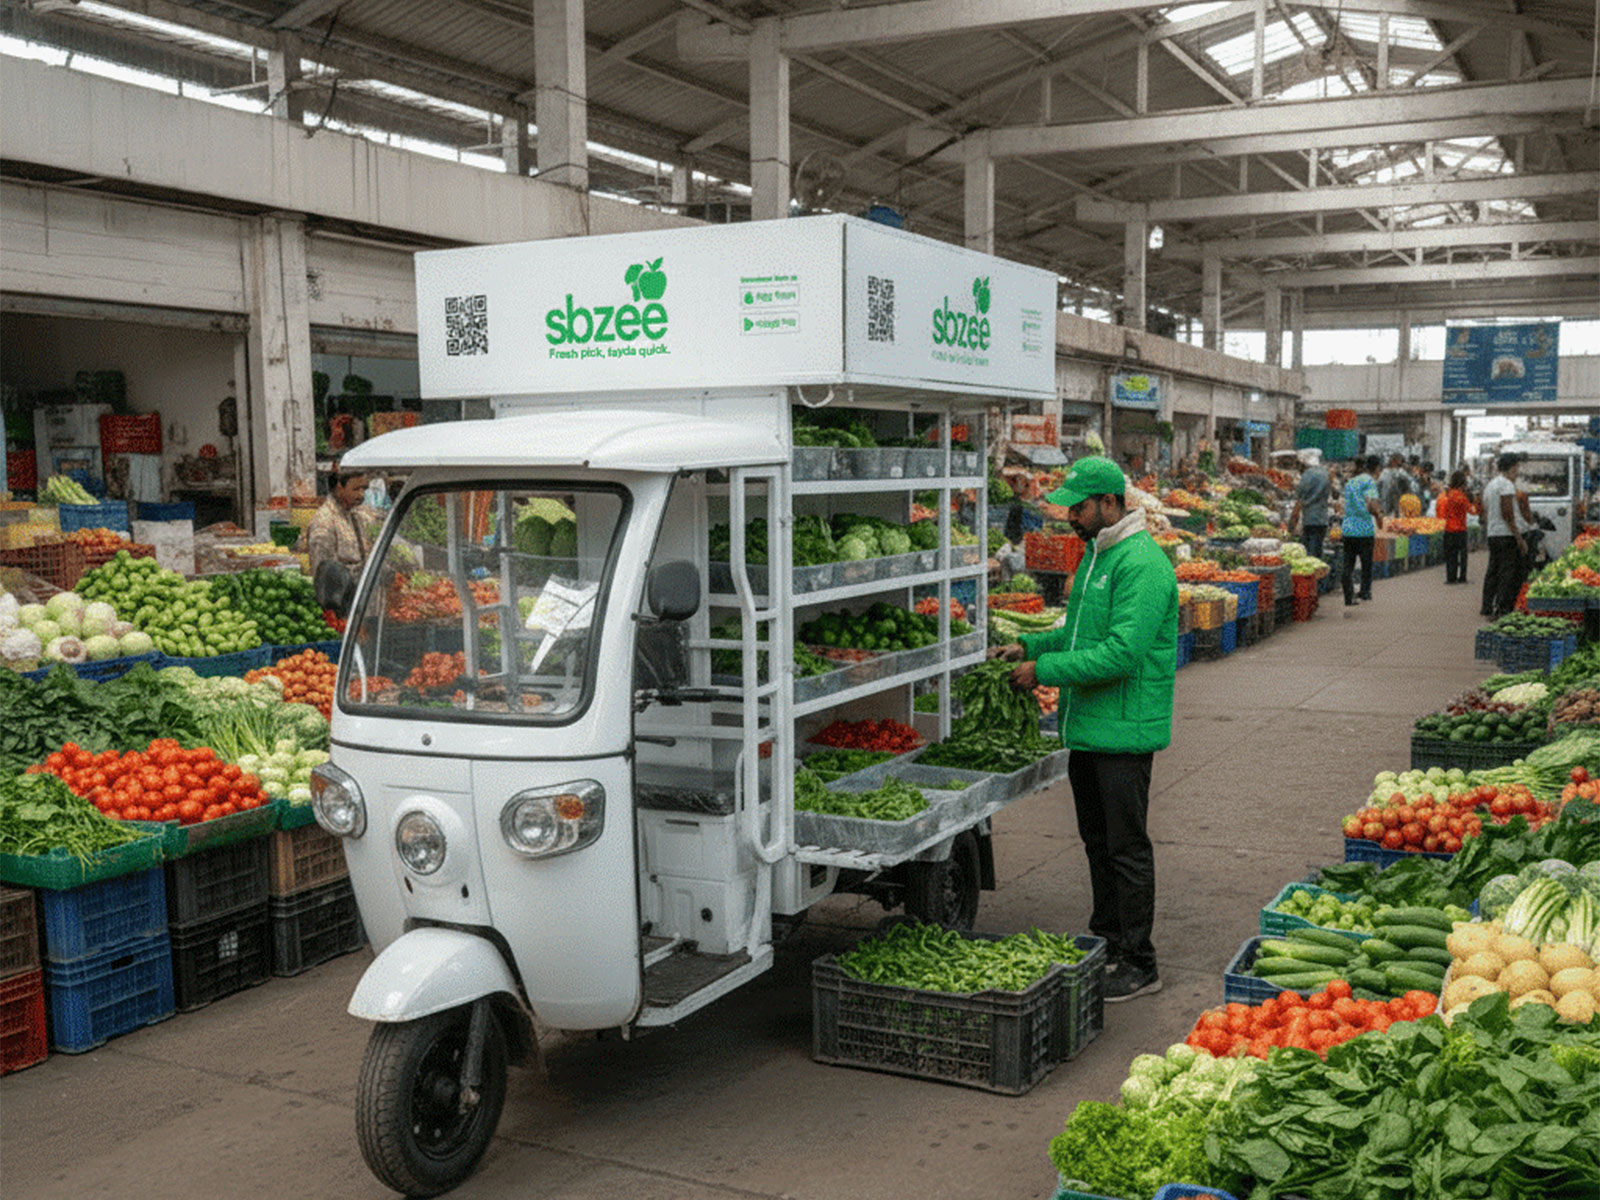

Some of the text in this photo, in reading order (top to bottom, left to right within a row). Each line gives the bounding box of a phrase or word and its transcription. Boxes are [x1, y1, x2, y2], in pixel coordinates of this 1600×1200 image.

[545, 293, 668, 345] sbzee
[932, 295, 991, 351] sbzee
[549, 348, 579, 359] Fresh
[580, 347, 606, 360] pick,
